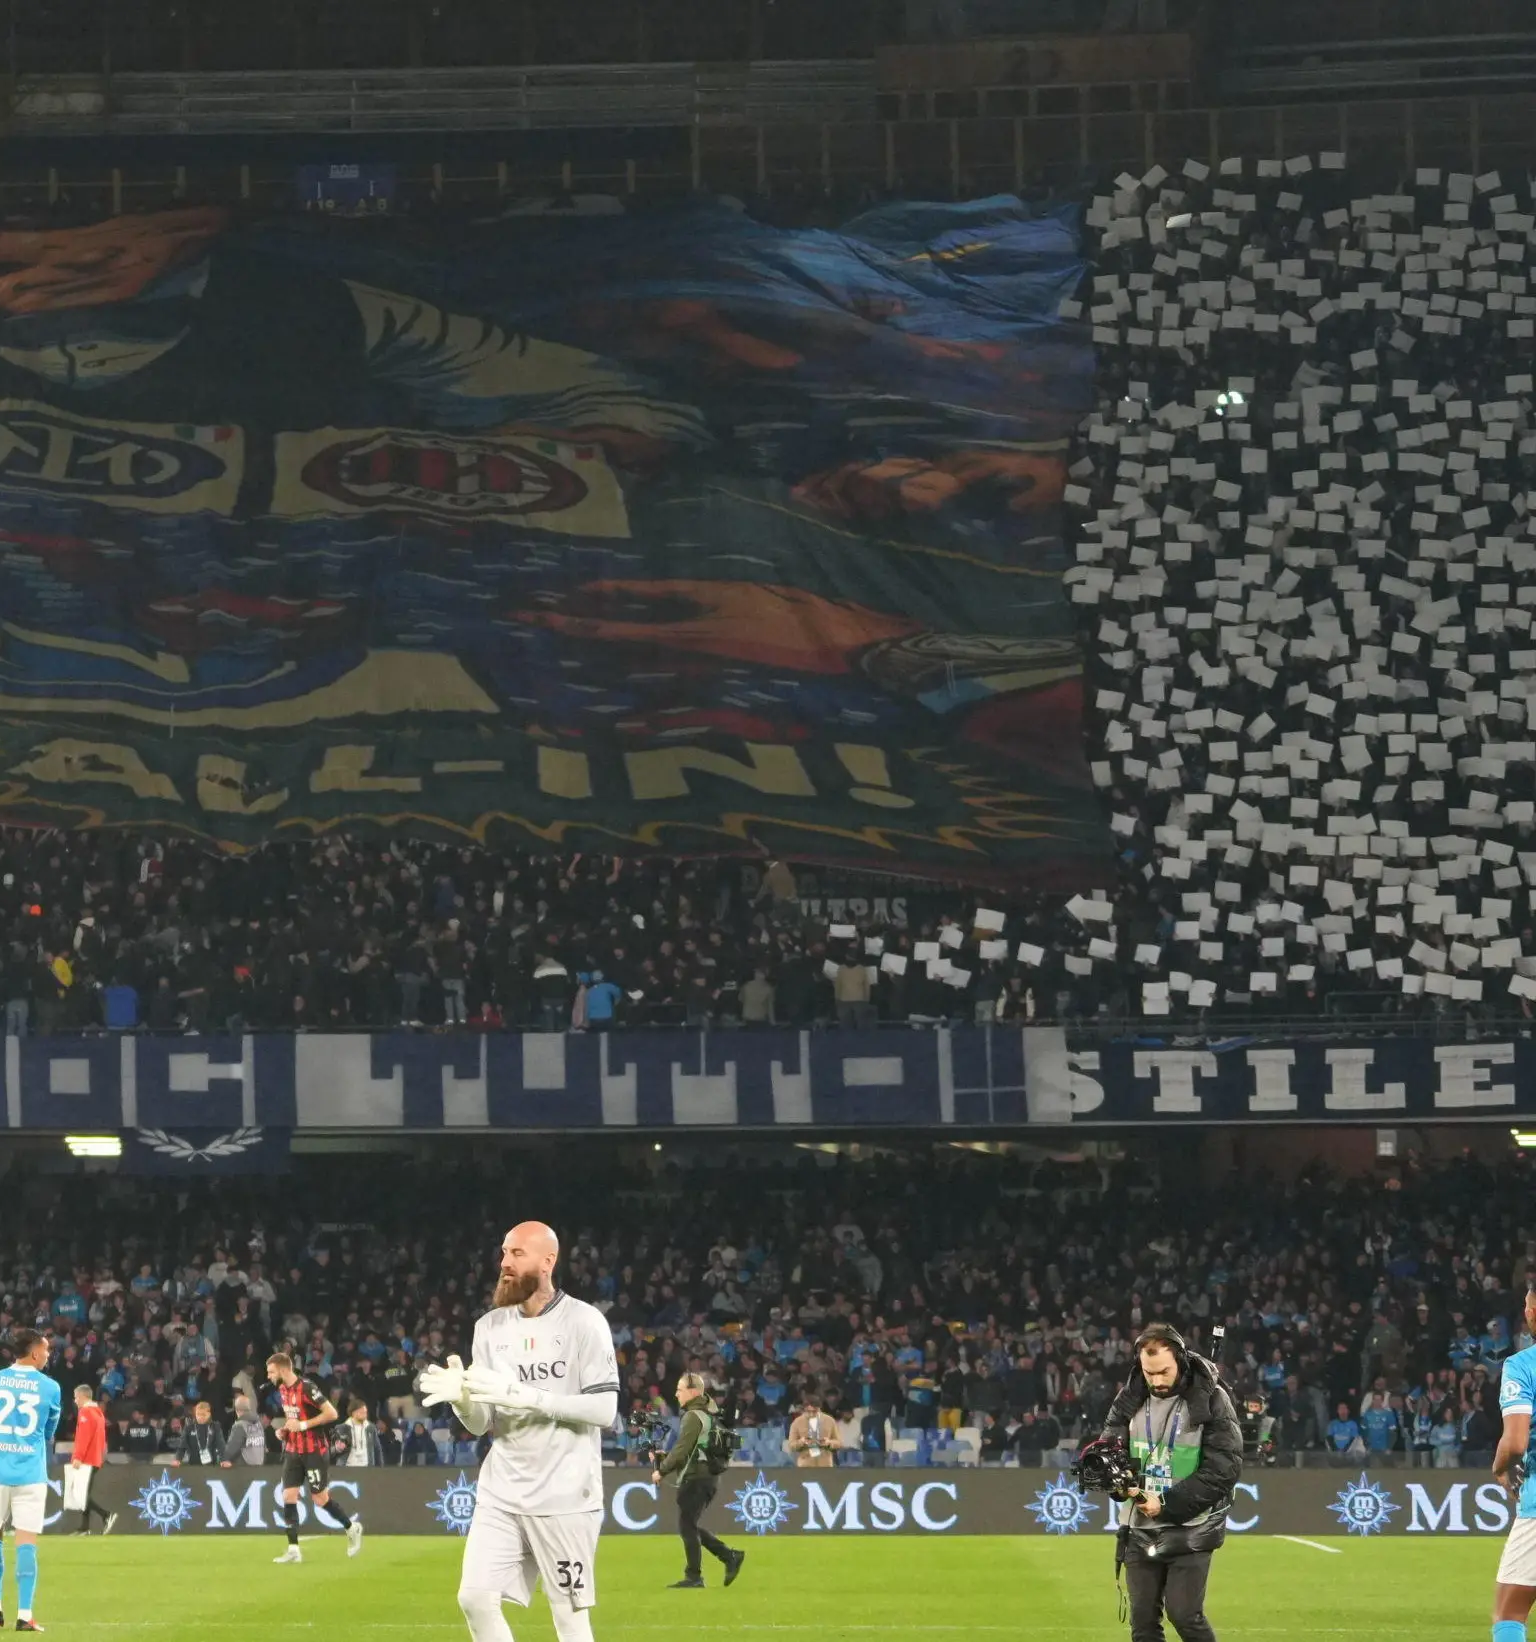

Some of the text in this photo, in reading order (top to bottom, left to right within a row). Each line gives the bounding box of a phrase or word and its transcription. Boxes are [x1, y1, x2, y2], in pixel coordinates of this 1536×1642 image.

[0, 1376, 39, 1391] GIOVANE
[516, 1361, 566, 1382] MSC
[802, 1481, 959, 1532] MSC
[1405, 1483, 1509, 1532] MS
[557, 1560, 585, 1589] 32
